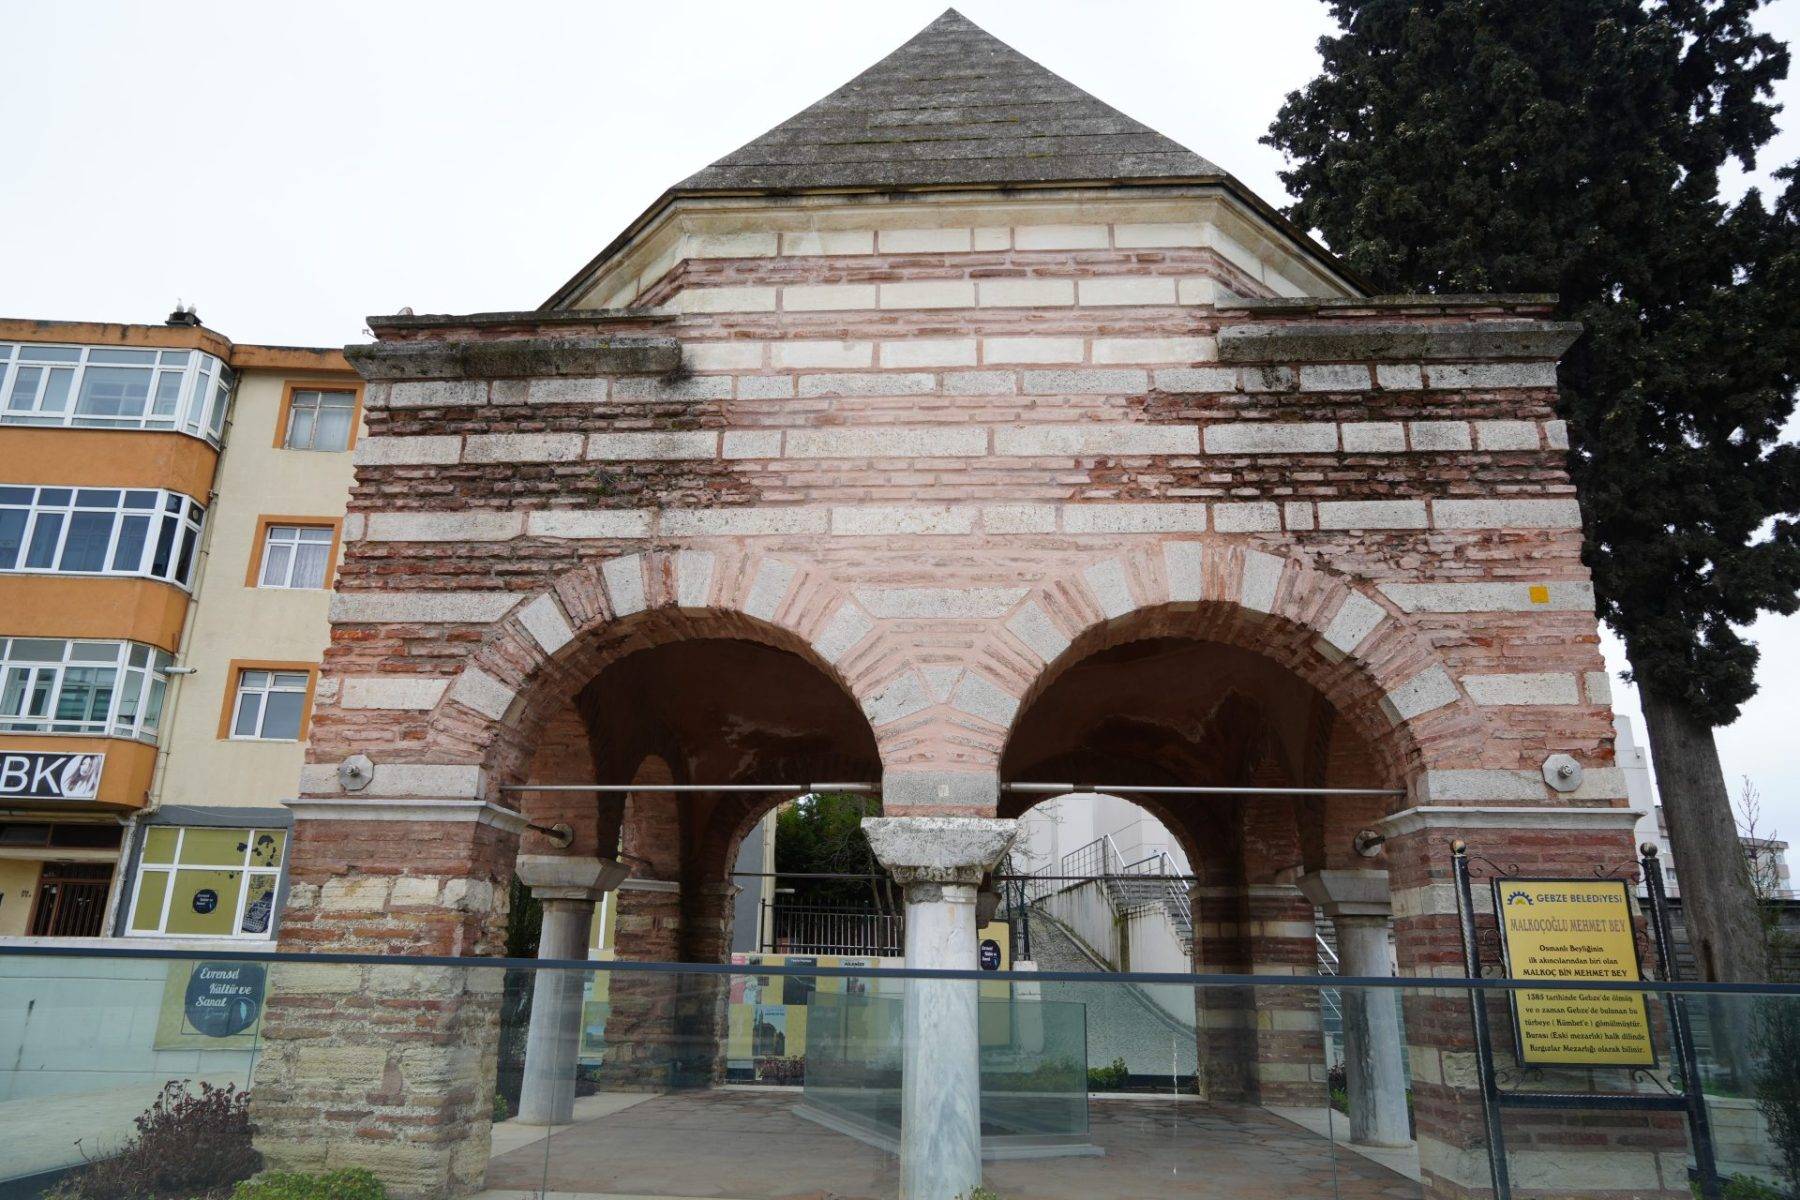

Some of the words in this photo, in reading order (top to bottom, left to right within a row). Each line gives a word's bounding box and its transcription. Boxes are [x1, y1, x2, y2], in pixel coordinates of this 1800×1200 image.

[0, 755, 67, 794] BK
[1536, 894, 1567, 903] GEBZE
[1510, 916, 1568, 934] MALKOÇOĞLU
[1570, 919, 1607, 932] MEHMET
[1609, 919, 1626, 932] BEY
[1539, 944, 1568, 952] Osmanlı
[1569, 944, 1604, 953] Beyliğinin
[1602, 957, 1618, 965] olan
[200, 966, 240, 979] Evrensel
[1523, 969, 1557, 978] MALKOÇ
[209, 983, 238, 994] Kültür
[238, 986, 252, 995] ve
[195, 995, 227, 1007] Sanat
[1600, 1007, 1628, 1015] bulunan
[1629, 1007, 1638, 1015] bu
